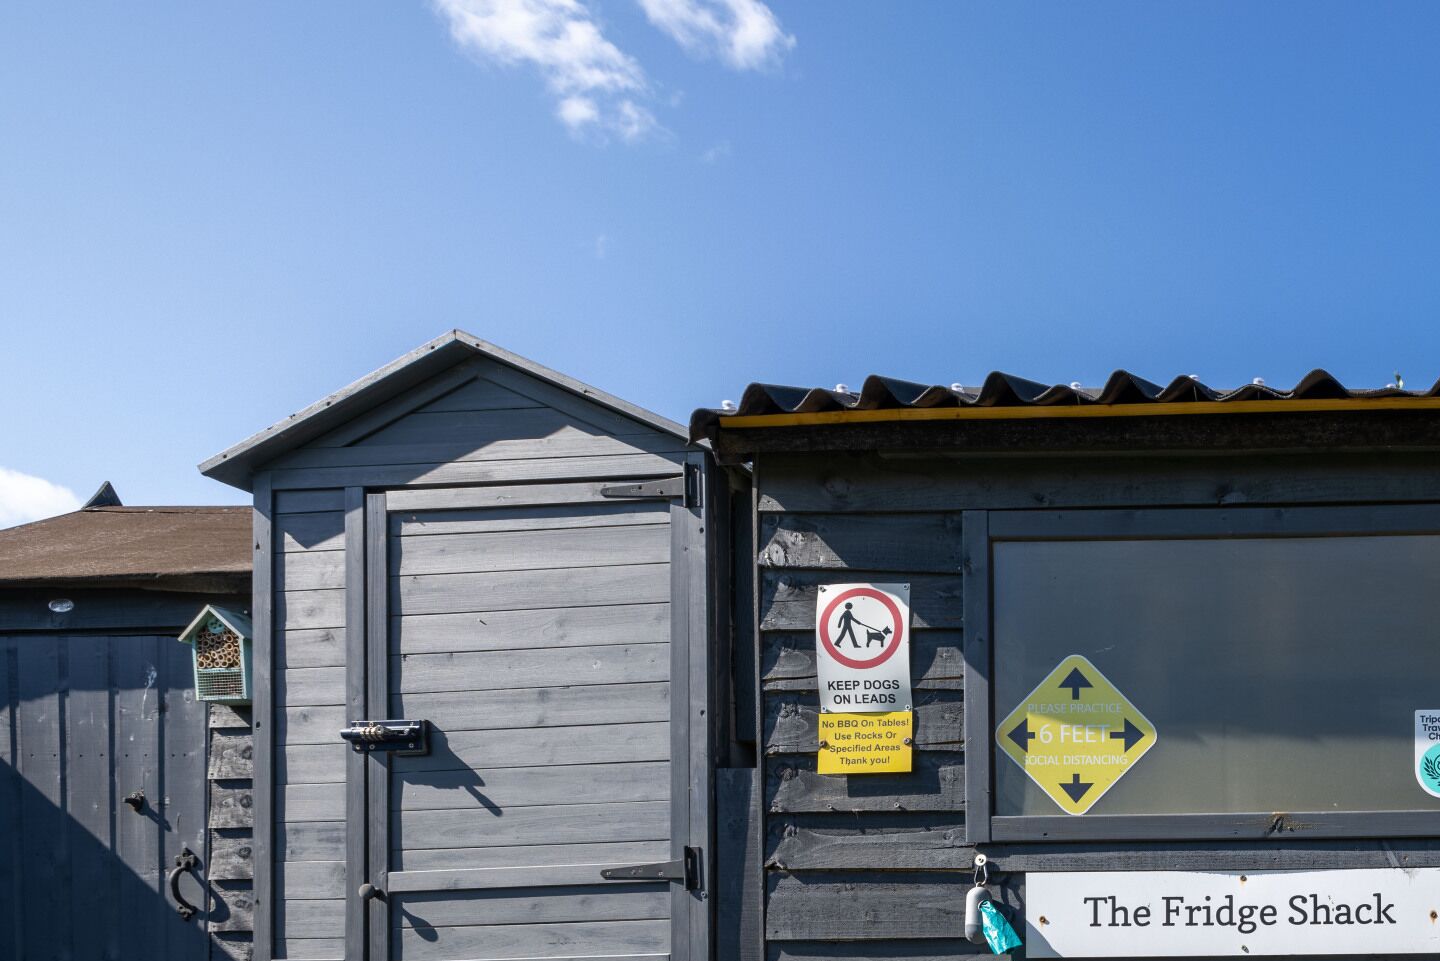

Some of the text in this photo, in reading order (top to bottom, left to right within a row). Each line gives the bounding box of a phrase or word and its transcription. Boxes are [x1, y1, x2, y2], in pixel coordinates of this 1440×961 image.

[828, 680, 900, 691] KEEP DOGS
[834, 694, 896, 704] ON LEADS
[1028, 703, 1122, 713] PLEASE PRACTICE
[838, 720, 858, 728] BBQ
[861, 720, 874, 728] On
[878, 719, 909, 727] Tables!
[855, 732, 883, 740] Rocks
[1040, 723, 1111, 744] 6 FEET
[830, 745, 872, 754] Specified
[840, 757, 890, 765] Thank you!
[1024, 754, 1129, 765] SOCIAL DISTANCING
[1083, 893, 1398, 935] The Fridge Shack
